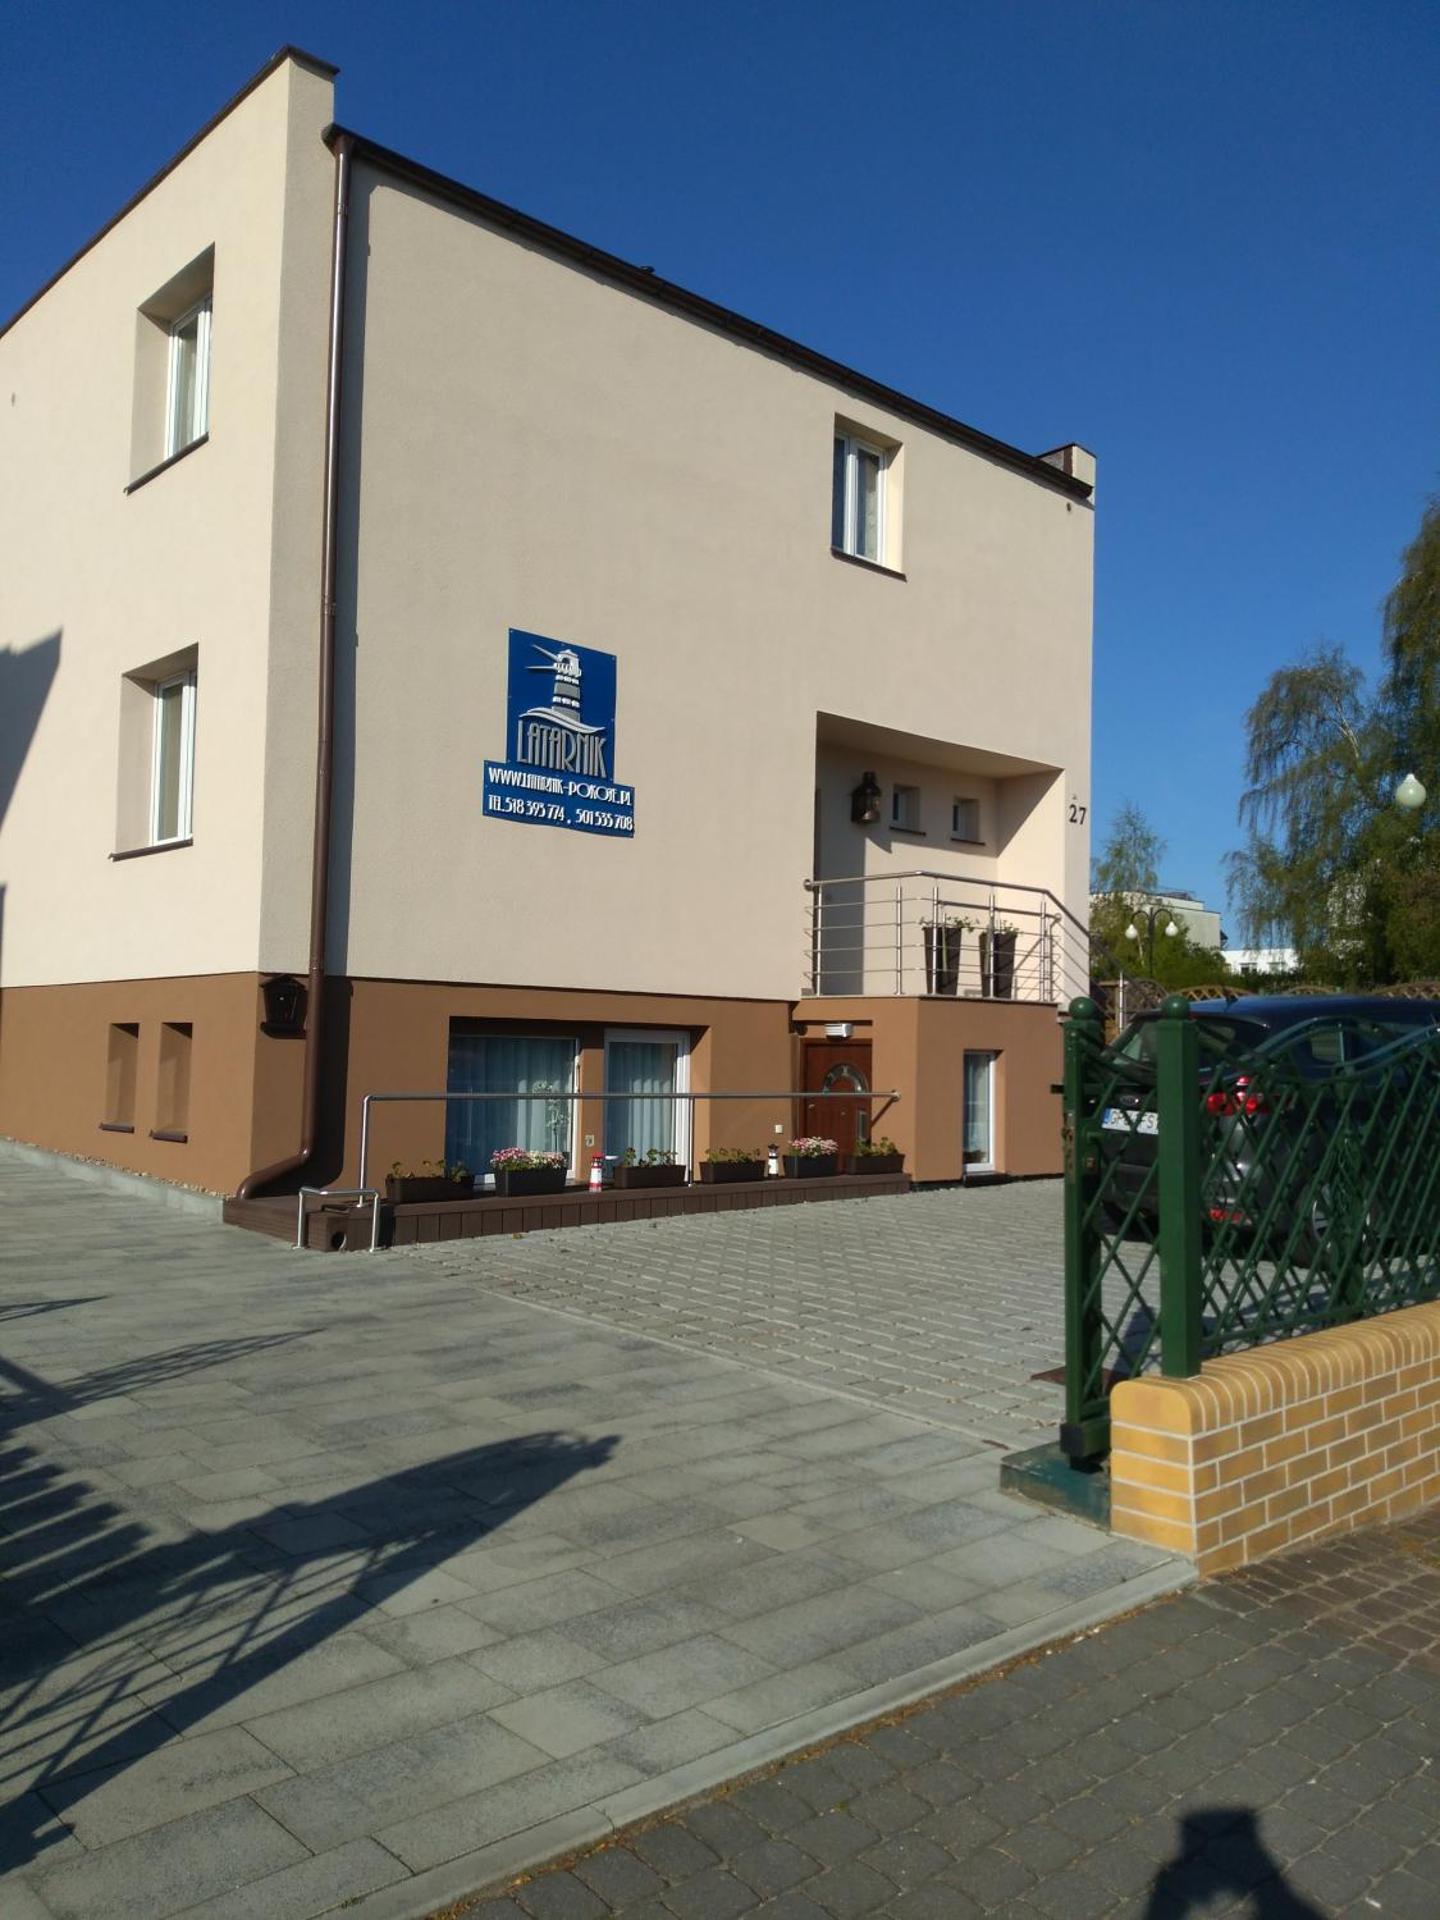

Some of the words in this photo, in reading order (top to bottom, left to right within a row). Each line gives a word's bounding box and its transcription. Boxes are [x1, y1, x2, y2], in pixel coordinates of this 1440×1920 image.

[517, 719, 607, 779] LATARNIK
[546, 803, 565, 822] 774
[575, 808, 594, 825] 501
[613, 814, 633, 831] 708
[1069, 803, 1087, 825] 27
